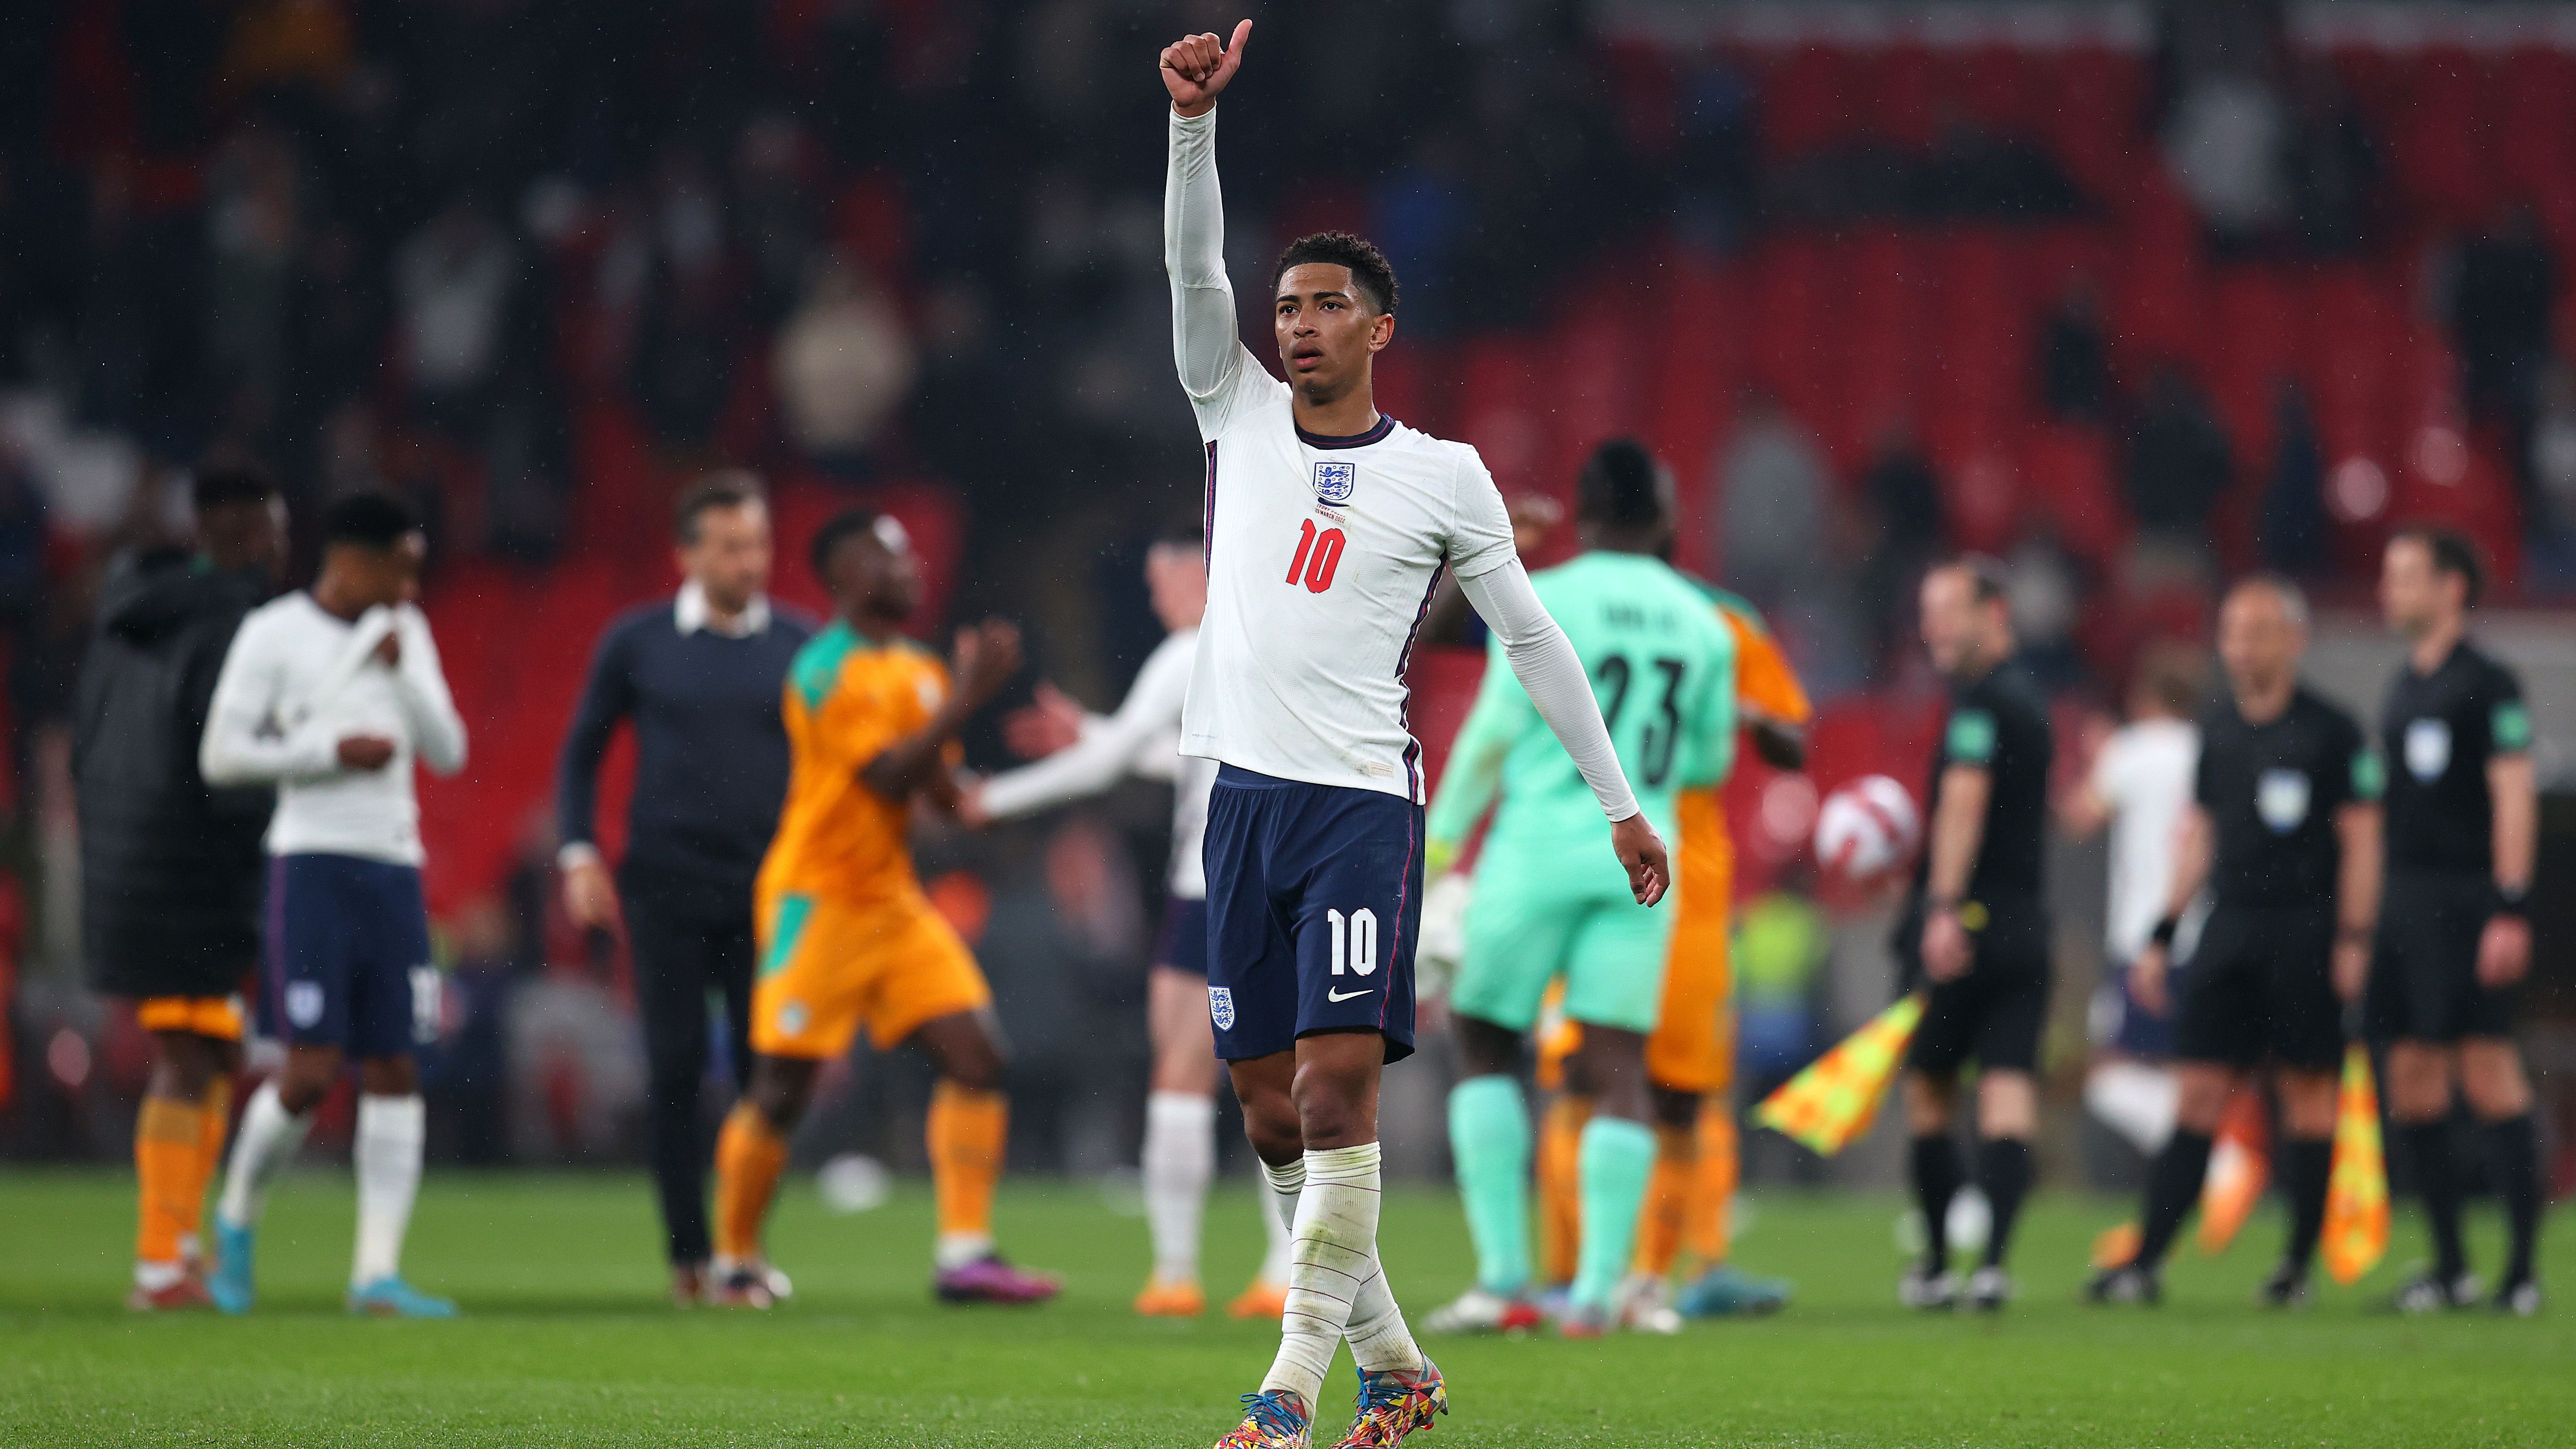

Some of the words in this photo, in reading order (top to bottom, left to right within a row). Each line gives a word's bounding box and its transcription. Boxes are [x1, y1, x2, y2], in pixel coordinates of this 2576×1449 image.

[1320, 510, 1334, 520] MARCH
[1286, 518, 1346, 593] 10
[1576, 651, 1686, 791] 23
[1328, 907, 1377, 976] 10
